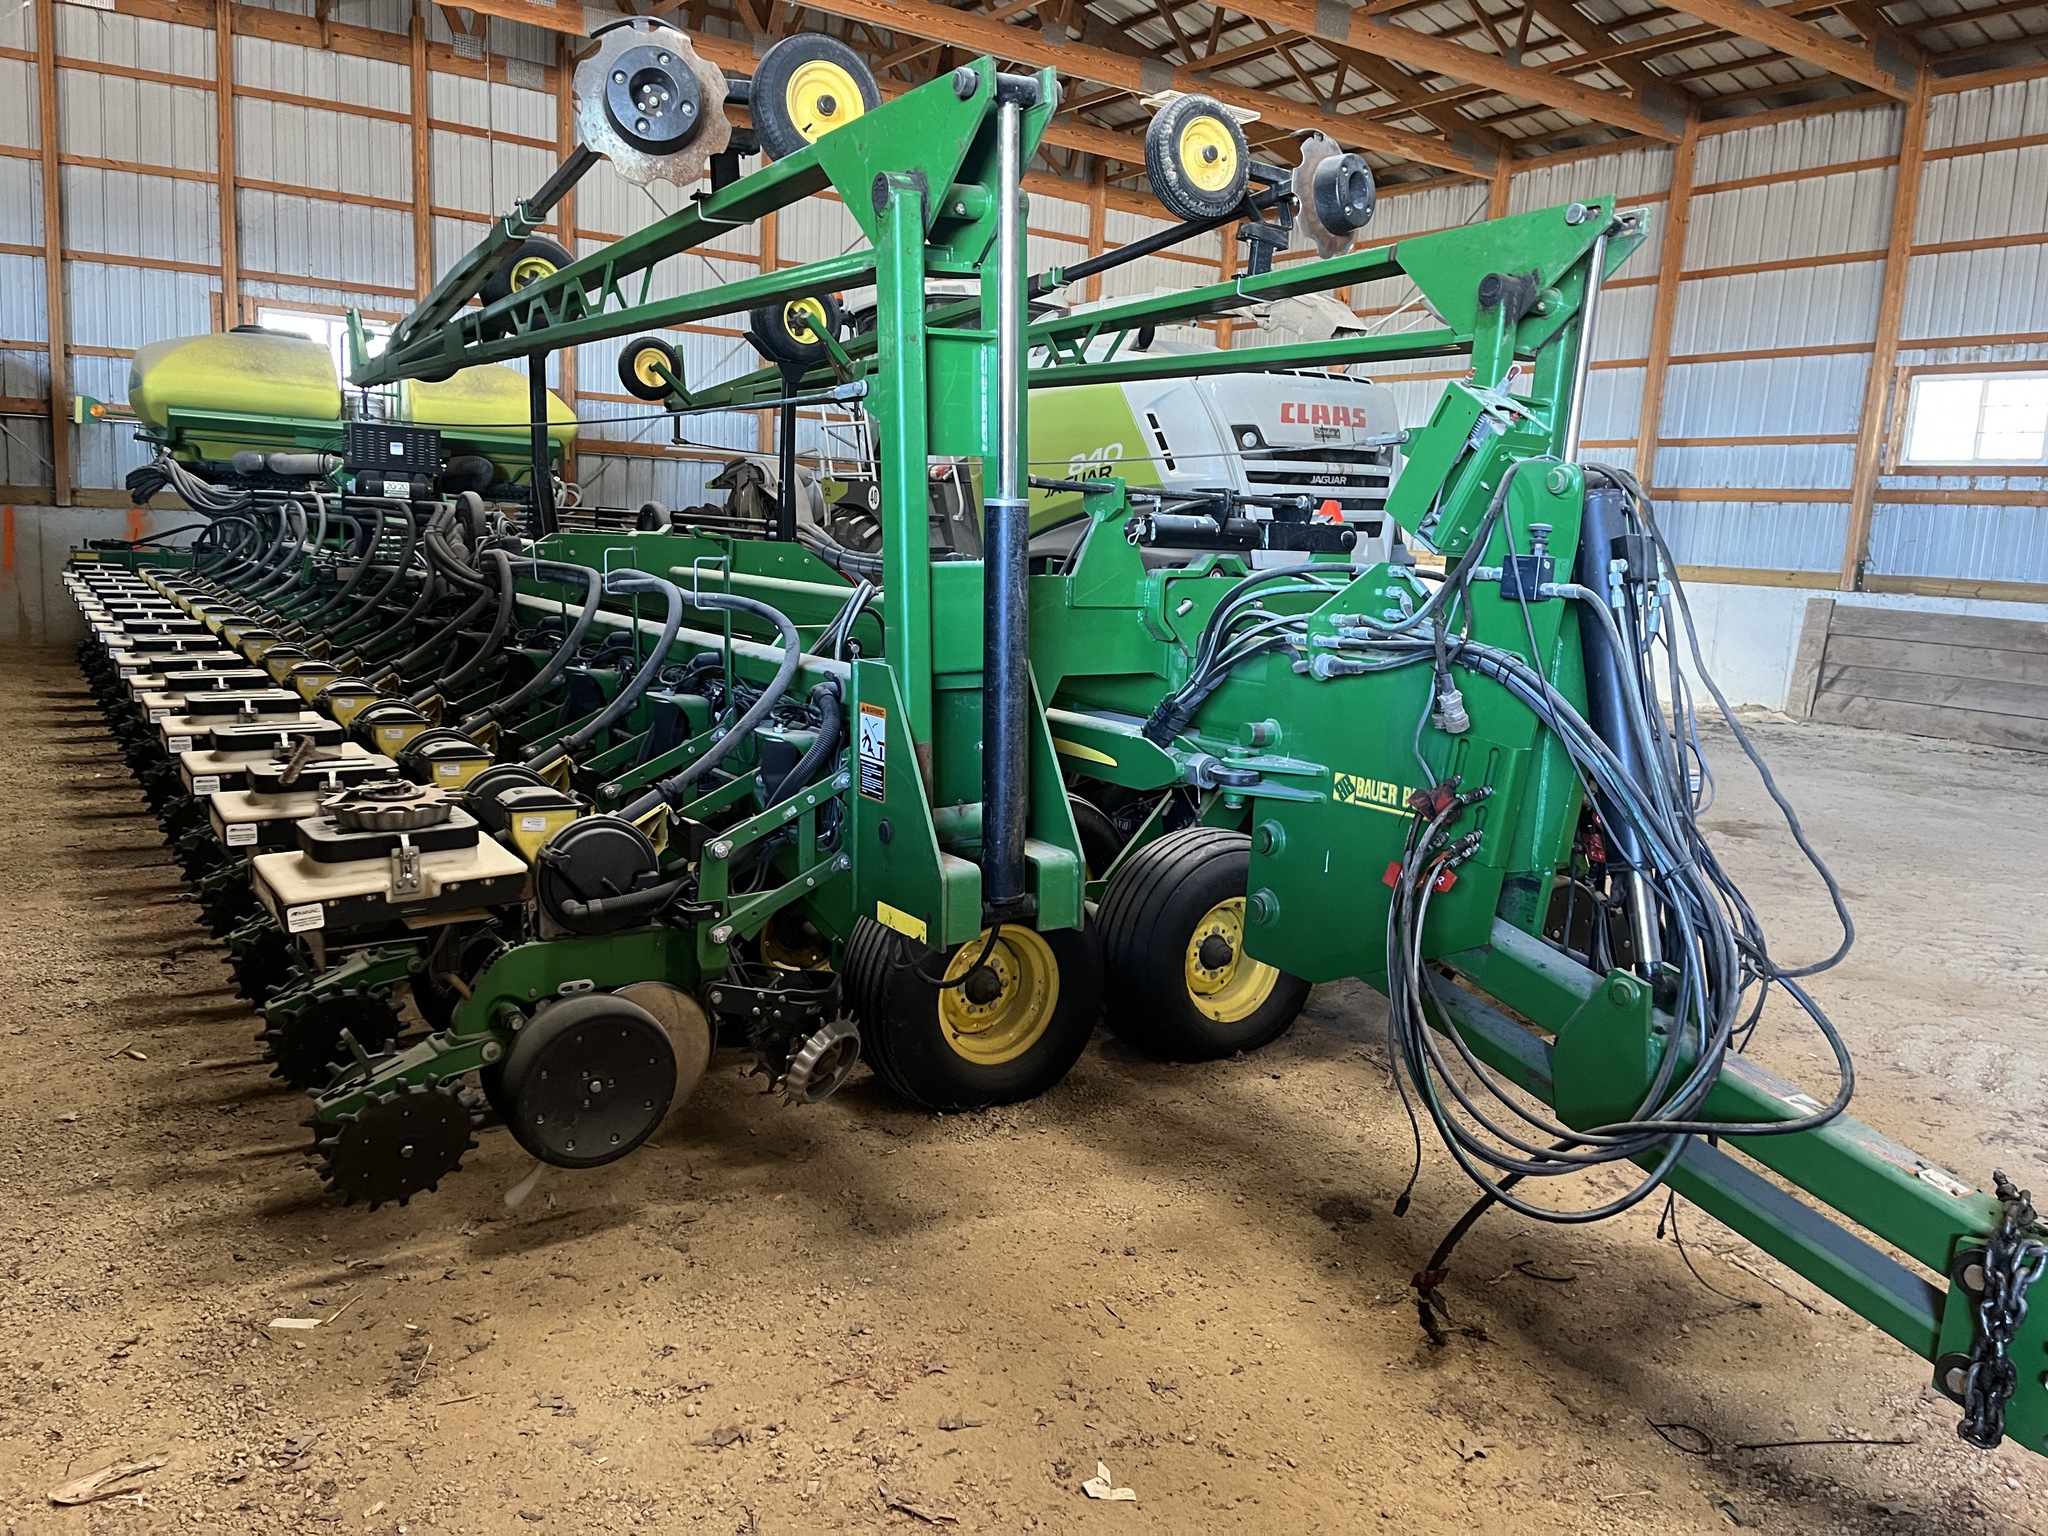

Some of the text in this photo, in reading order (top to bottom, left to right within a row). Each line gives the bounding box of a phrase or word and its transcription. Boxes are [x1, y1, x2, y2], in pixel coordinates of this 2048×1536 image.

[1281, 402, 1366, 428] CLAAS
[1068, 442, 1123, 476] 840
[385, 482, 408, 490] 20/20
[1310, 475, 1347, 485] JAGUAR
[870, 489, 878, 504] 40
[1356, 776, 1398, 806] BAUER
